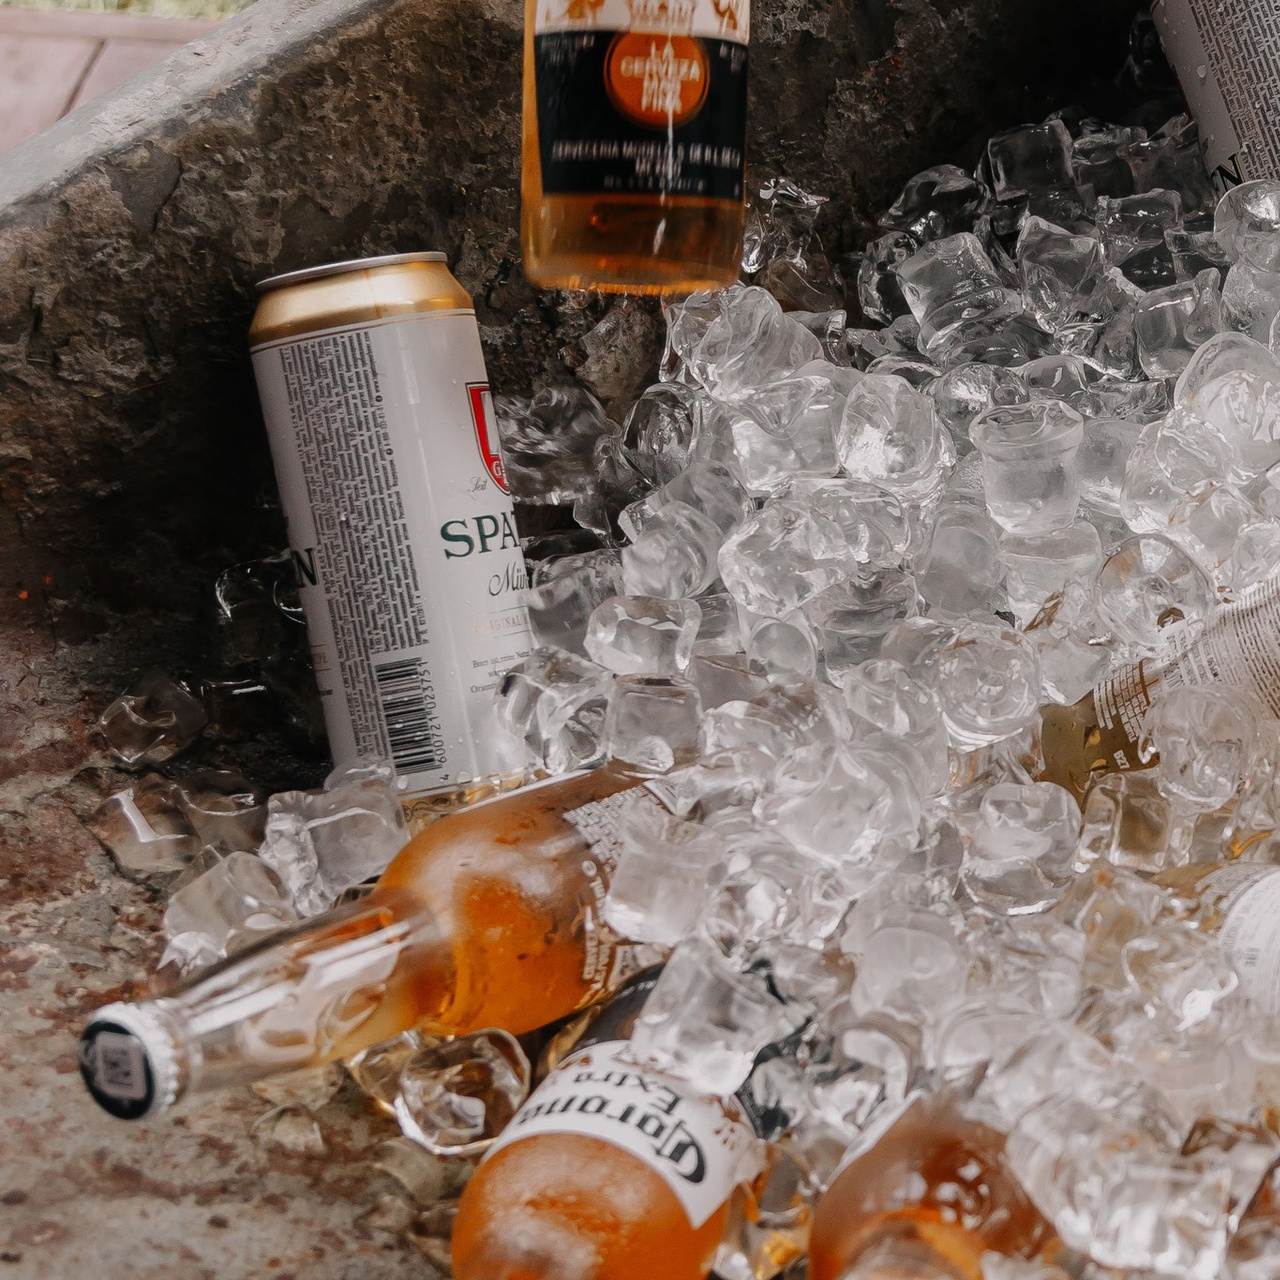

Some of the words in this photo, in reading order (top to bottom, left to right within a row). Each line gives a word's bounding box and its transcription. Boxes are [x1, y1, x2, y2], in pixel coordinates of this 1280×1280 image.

[440, 511, 520, 559] SPA
[422, 660, 438, 711] 023751
[426, 711, 448, 766] 600721
[1112, 748, 1130, 771] B27
[574, 1072, 683, 1115] Extra
[518, 1095, 706, 1183] Corona
